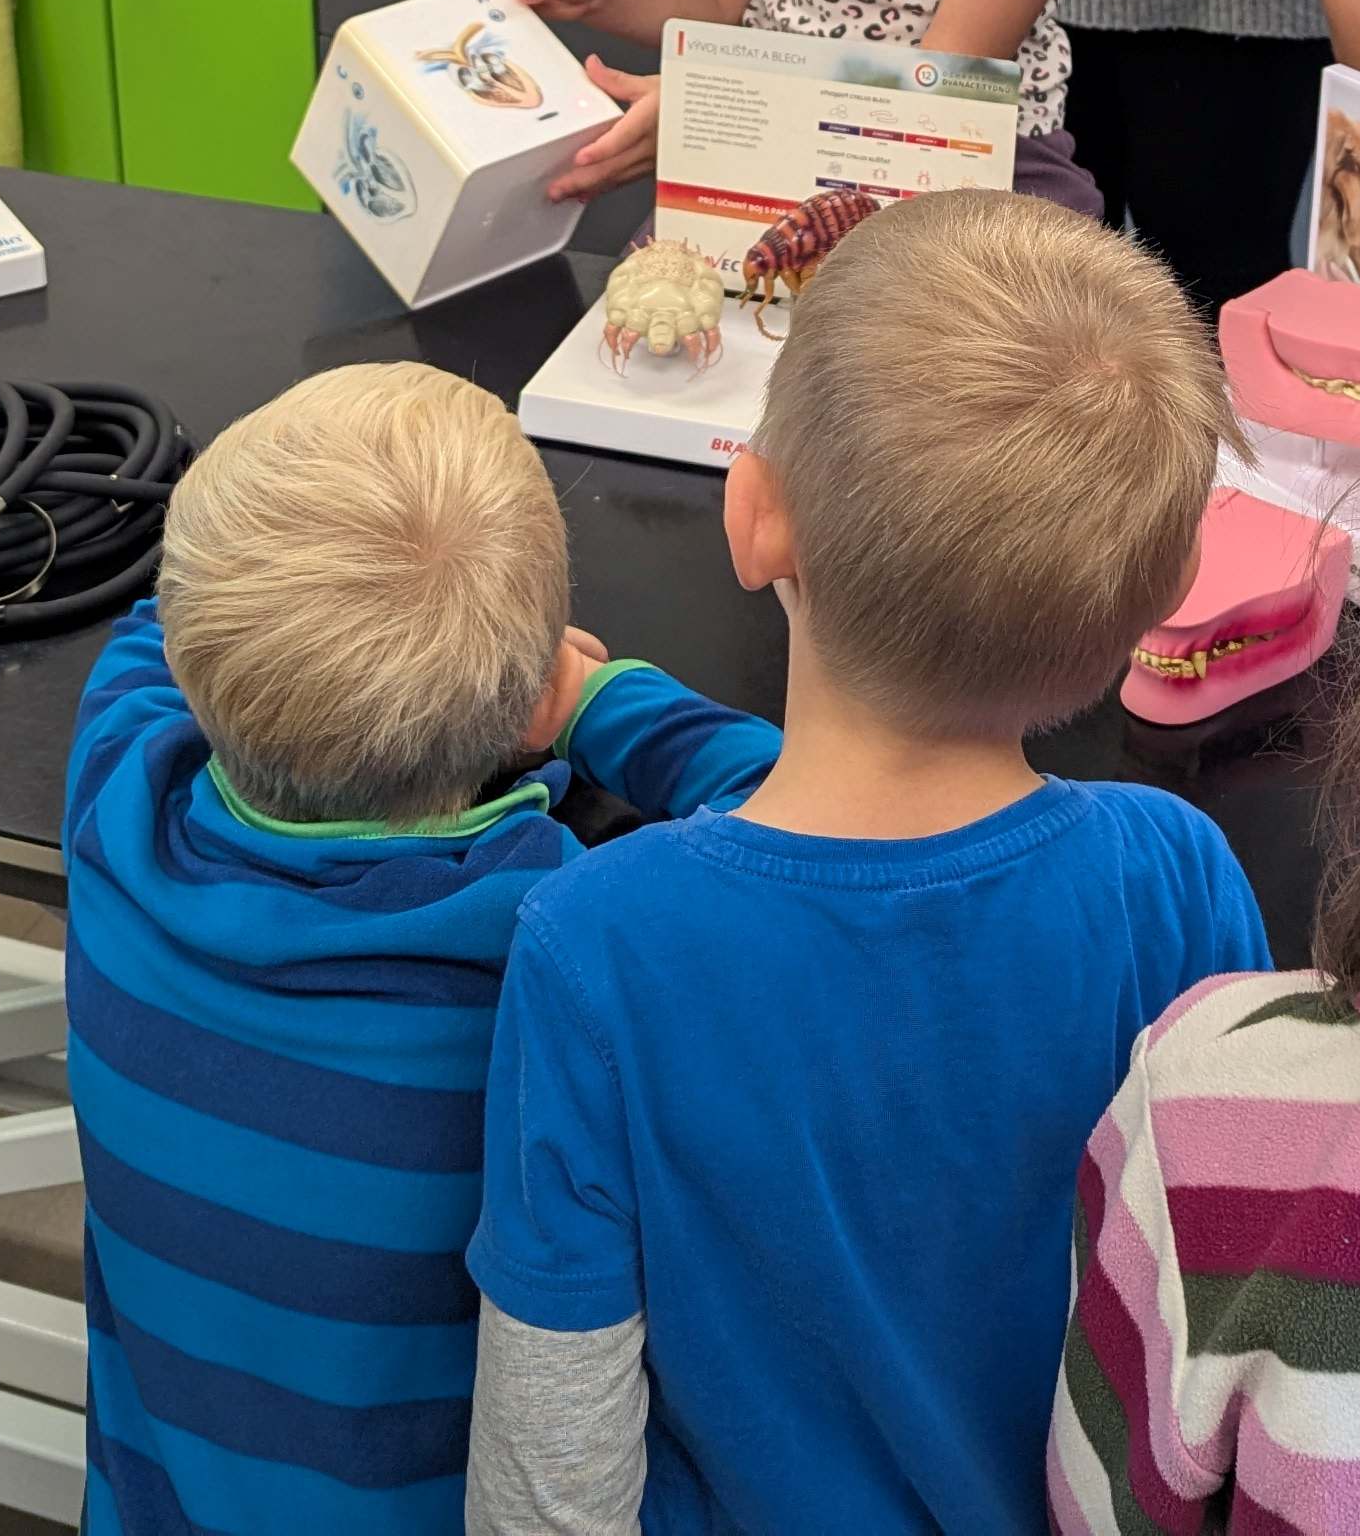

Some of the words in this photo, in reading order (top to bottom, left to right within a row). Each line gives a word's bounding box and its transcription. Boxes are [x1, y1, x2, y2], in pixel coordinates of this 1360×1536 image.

[771, 50, 807, 65] BLECH
[921, 71, 932, 81] 12
[698, 195, 715, 205] PRO
[748, 204, 763, 215] BOJ
[710, 438, 750, 459] BRA
